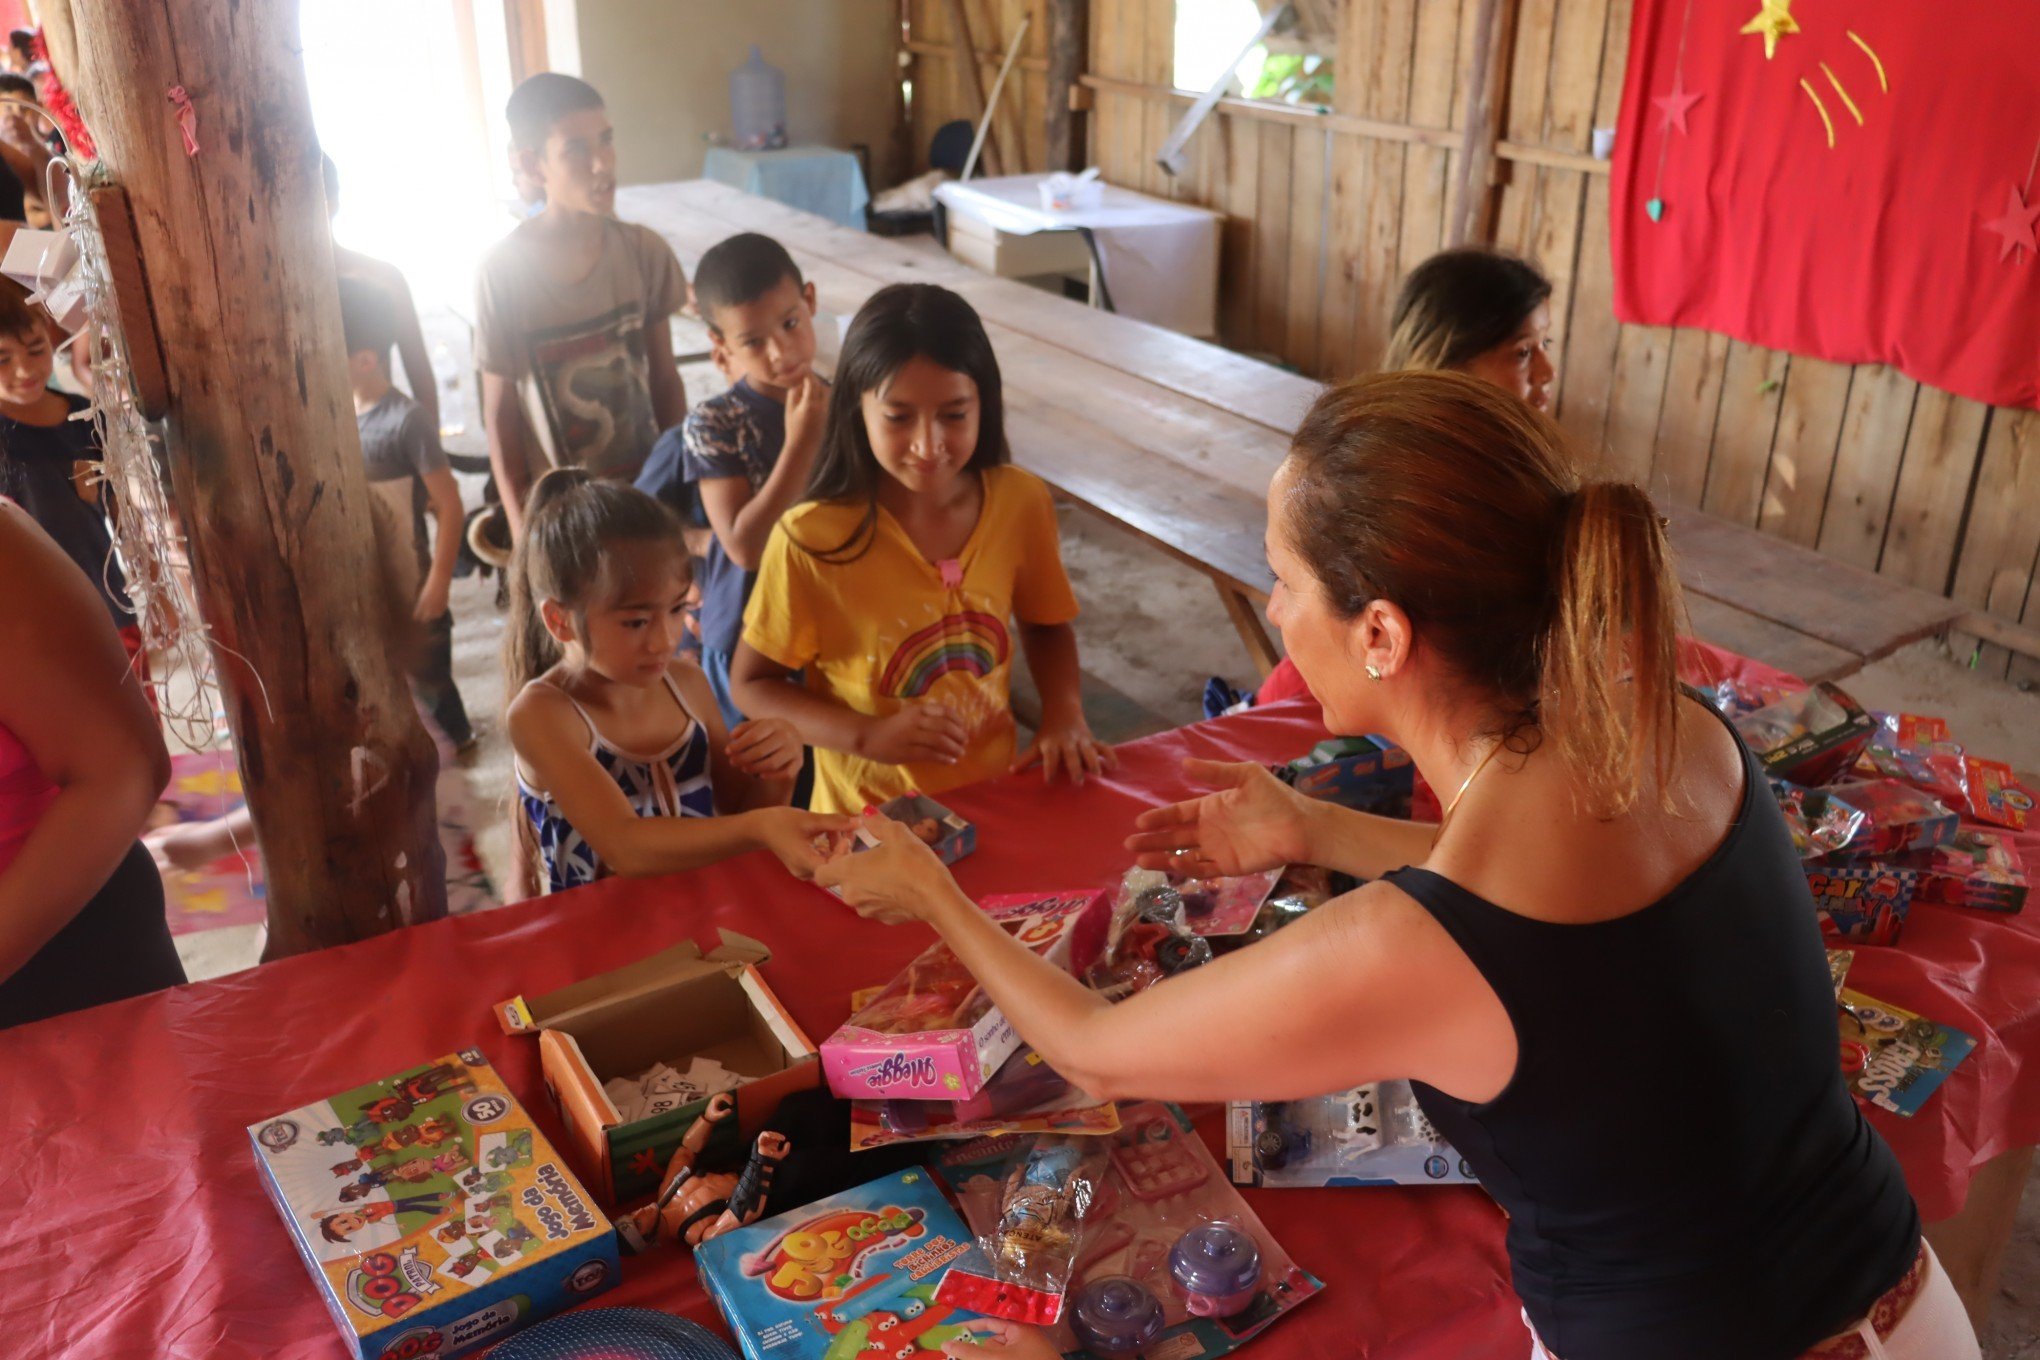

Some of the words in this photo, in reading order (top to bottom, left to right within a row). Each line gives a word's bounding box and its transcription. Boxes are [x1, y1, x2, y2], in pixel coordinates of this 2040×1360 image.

[1808, 873, 1865, 899] Car
[867, 1051, 938, 1088] Meggie
[472, 1102, 496, 1120] 50
[523, 1187, 544, 1206] da
[537, 1163, 596, 1231] Memória
[536, 1206, 570, 1239] Jogo
[360, 1253, 423, 1319] DOG
[402, 1259, 426, 1288] PATROL
[452, 1317, 480, 1334] Jogo
[482, 1310, 497, 1321] da
[453, 1314, 511, 1346] Memória
